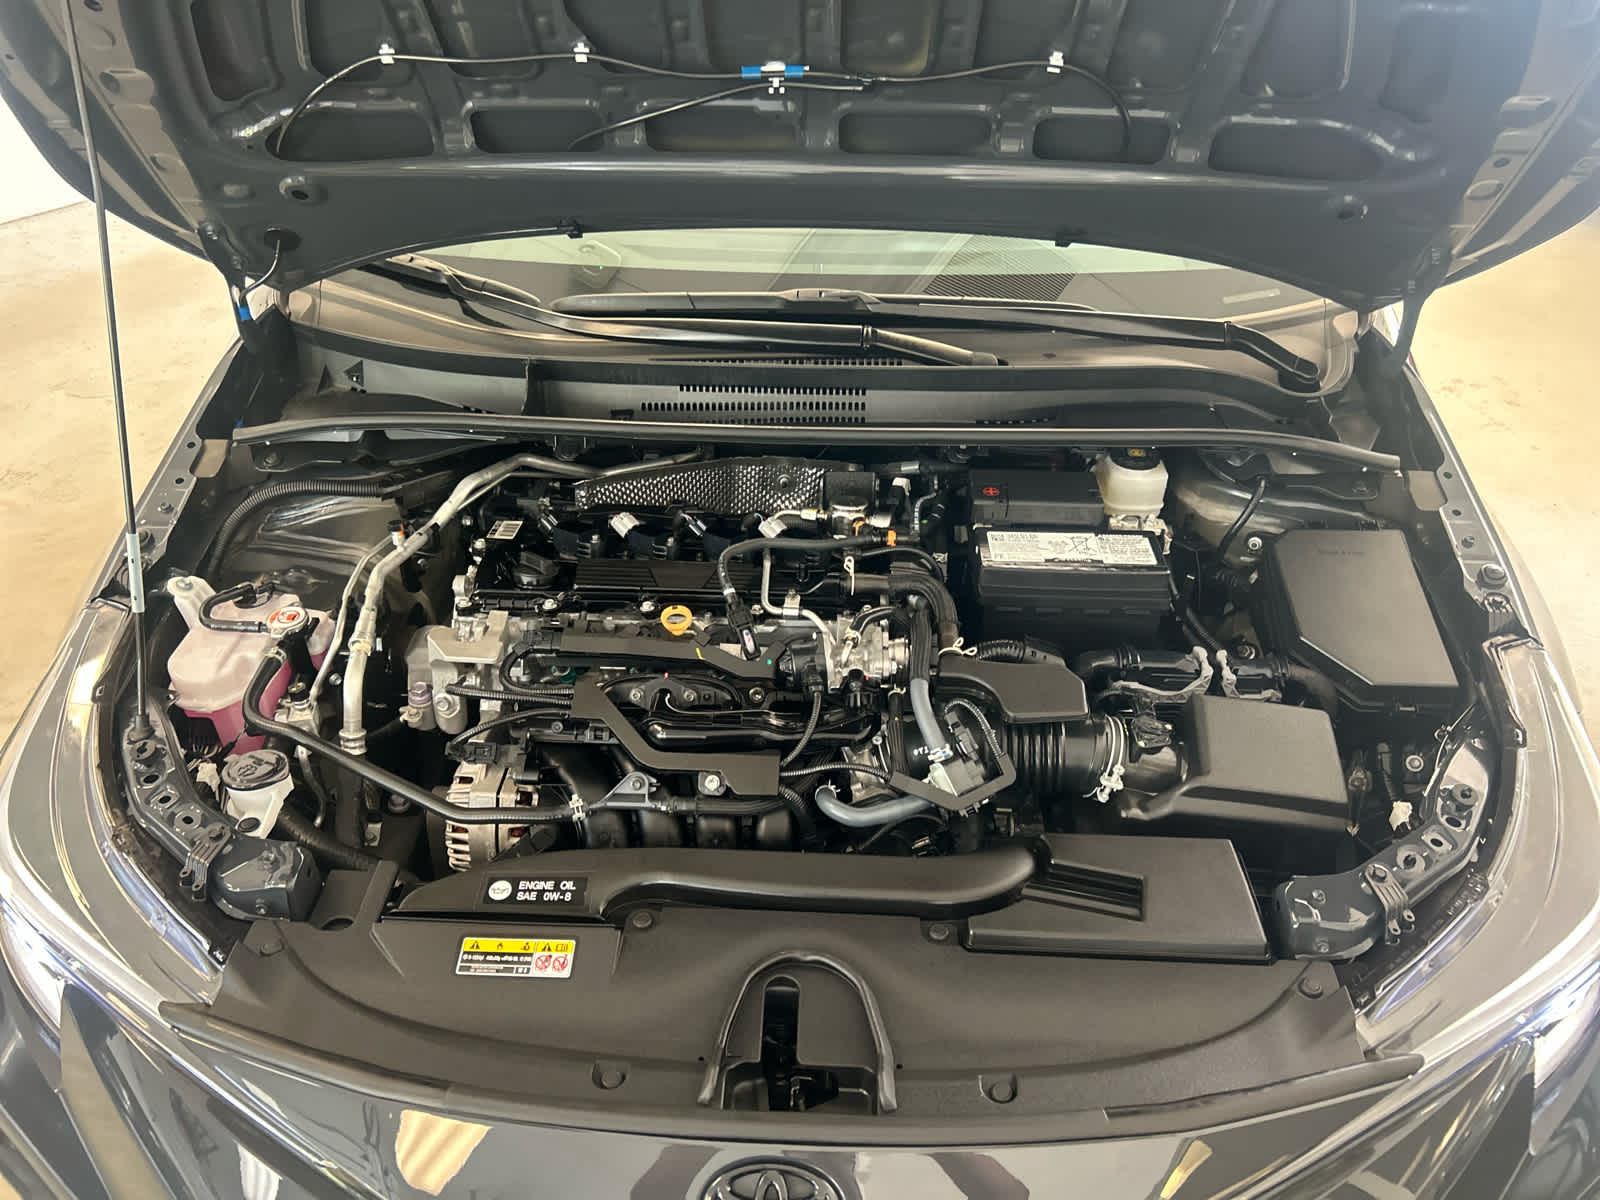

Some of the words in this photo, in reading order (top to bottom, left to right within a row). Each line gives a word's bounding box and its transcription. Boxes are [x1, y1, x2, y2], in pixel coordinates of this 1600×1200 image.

[518, 880, 555, 890] ENGINE
[560, 880, 576, 890] OIL
[516, 891, 538, 901] SAE
[543, 891, 572, 901] 0W-8
